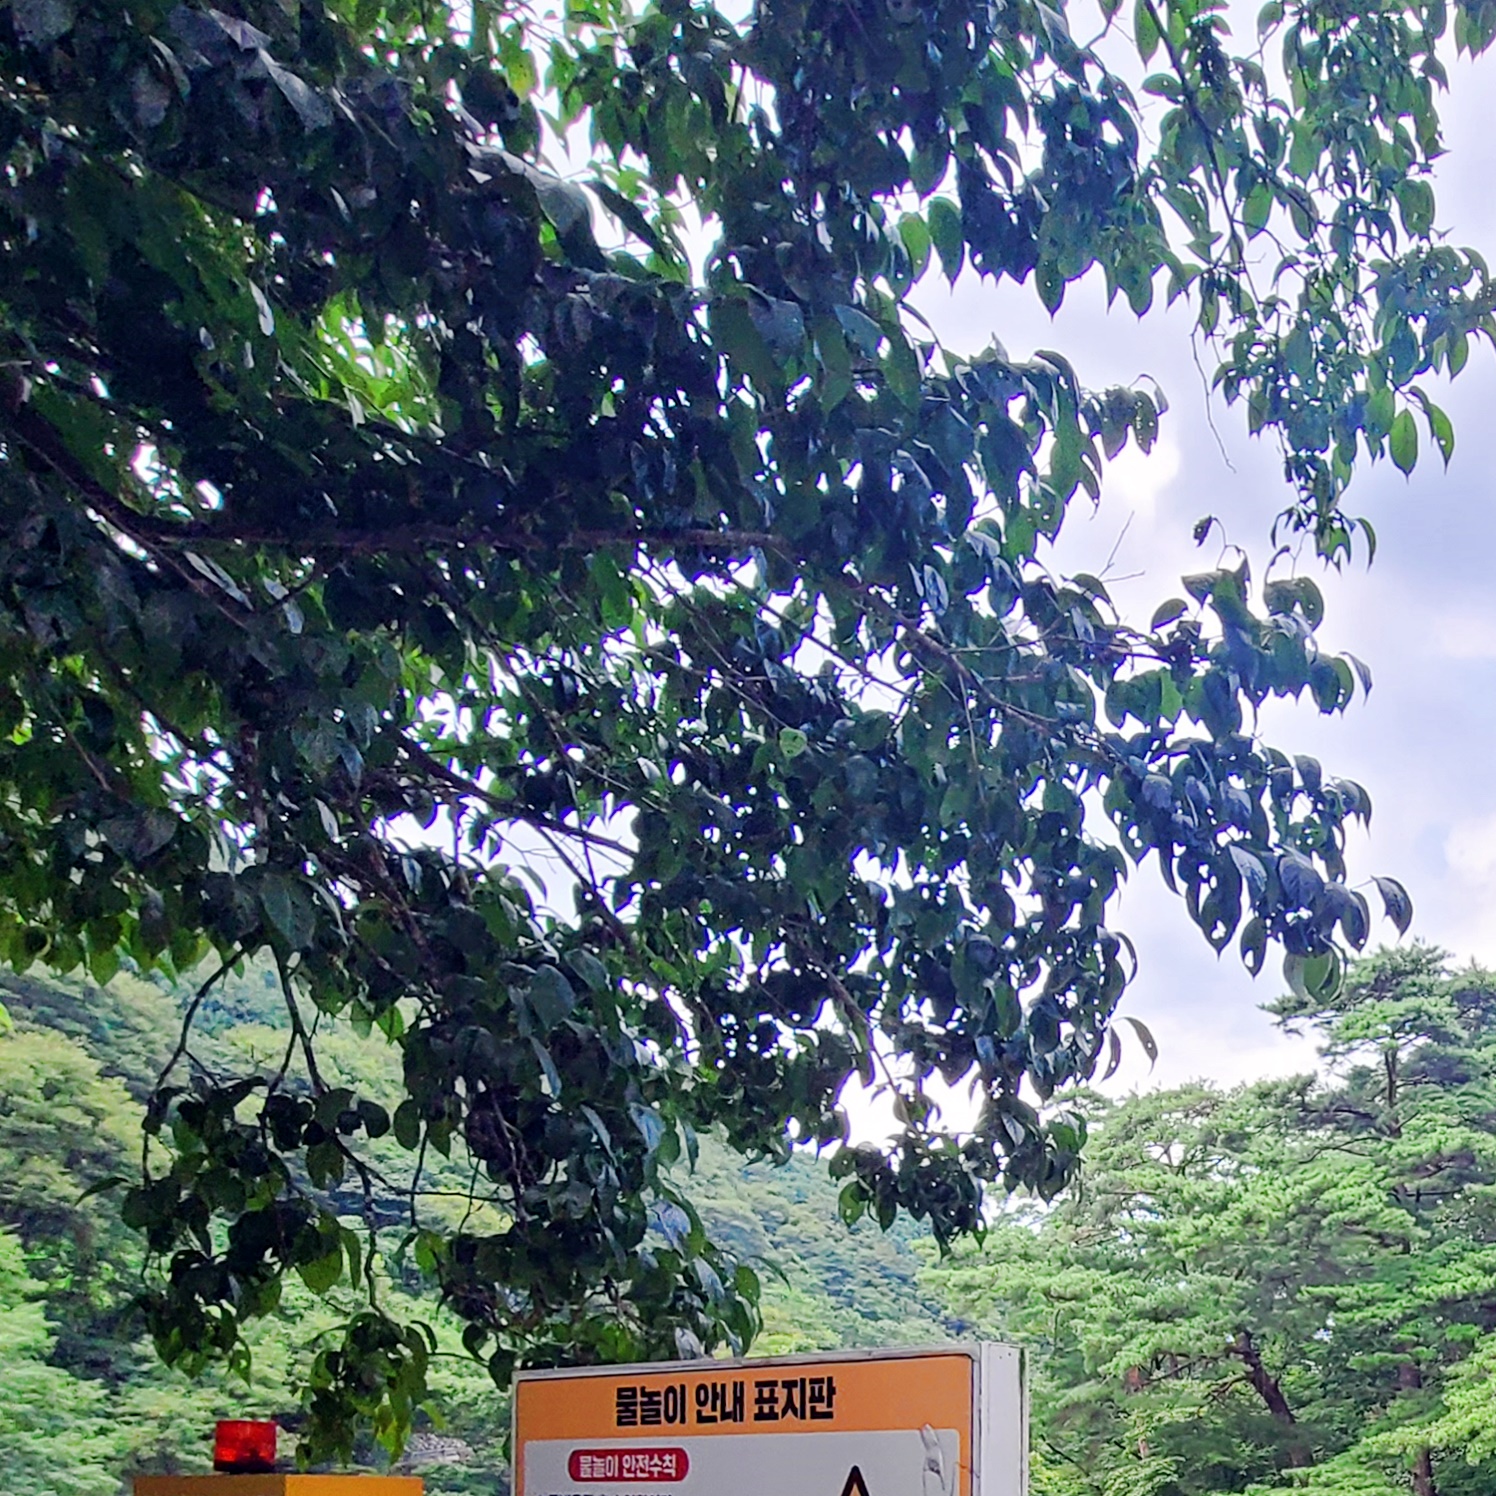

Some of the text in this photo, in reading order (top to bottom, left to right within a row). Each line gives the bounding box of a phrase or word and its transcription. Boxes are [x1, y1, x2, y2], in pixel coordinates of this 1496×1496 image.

[616, 1376, 836, 1426] 물놀이 안내 표지판
[578, 1454, 676, 1479] 물놀이 안전수칙
